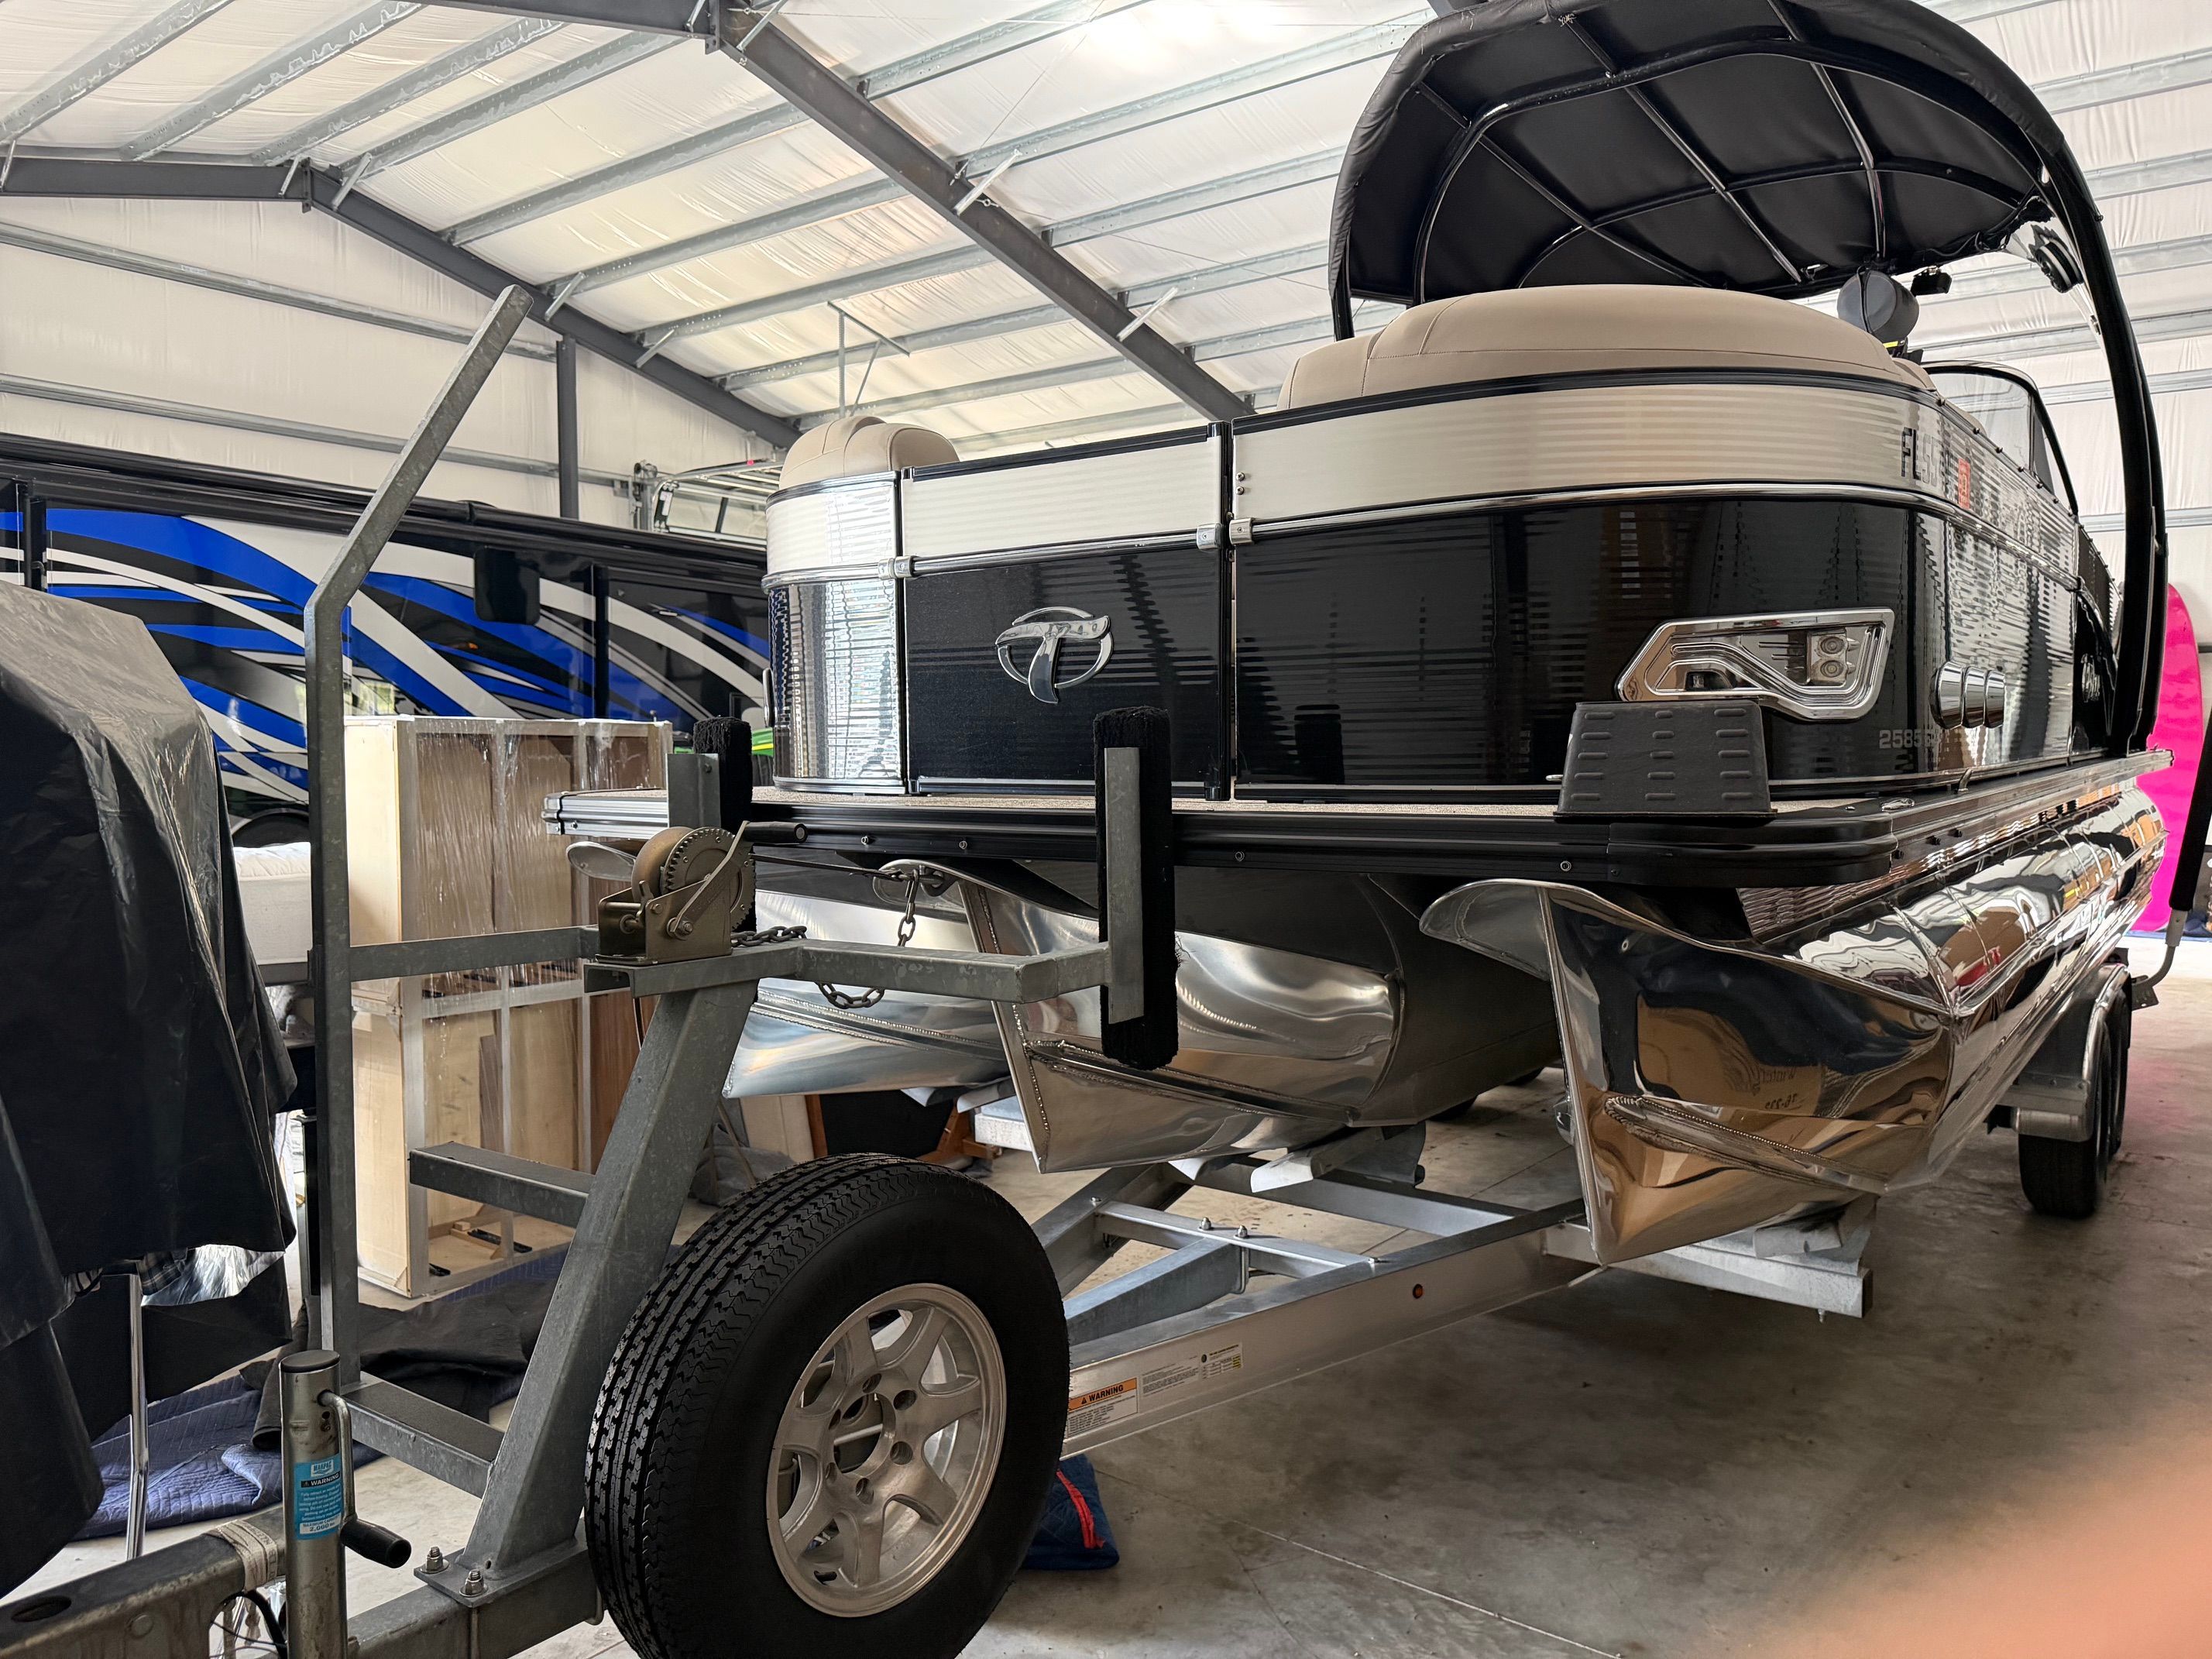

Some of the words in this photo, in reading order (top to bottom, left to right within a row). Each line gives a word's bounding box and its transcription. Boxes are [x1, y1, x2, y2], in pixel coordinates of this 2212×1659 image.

[1879, 730, 1922, 749] 2585
[1088, 1385, 1124, 1402] WARNING
[311, 1472, 339, 1486] WARNING
